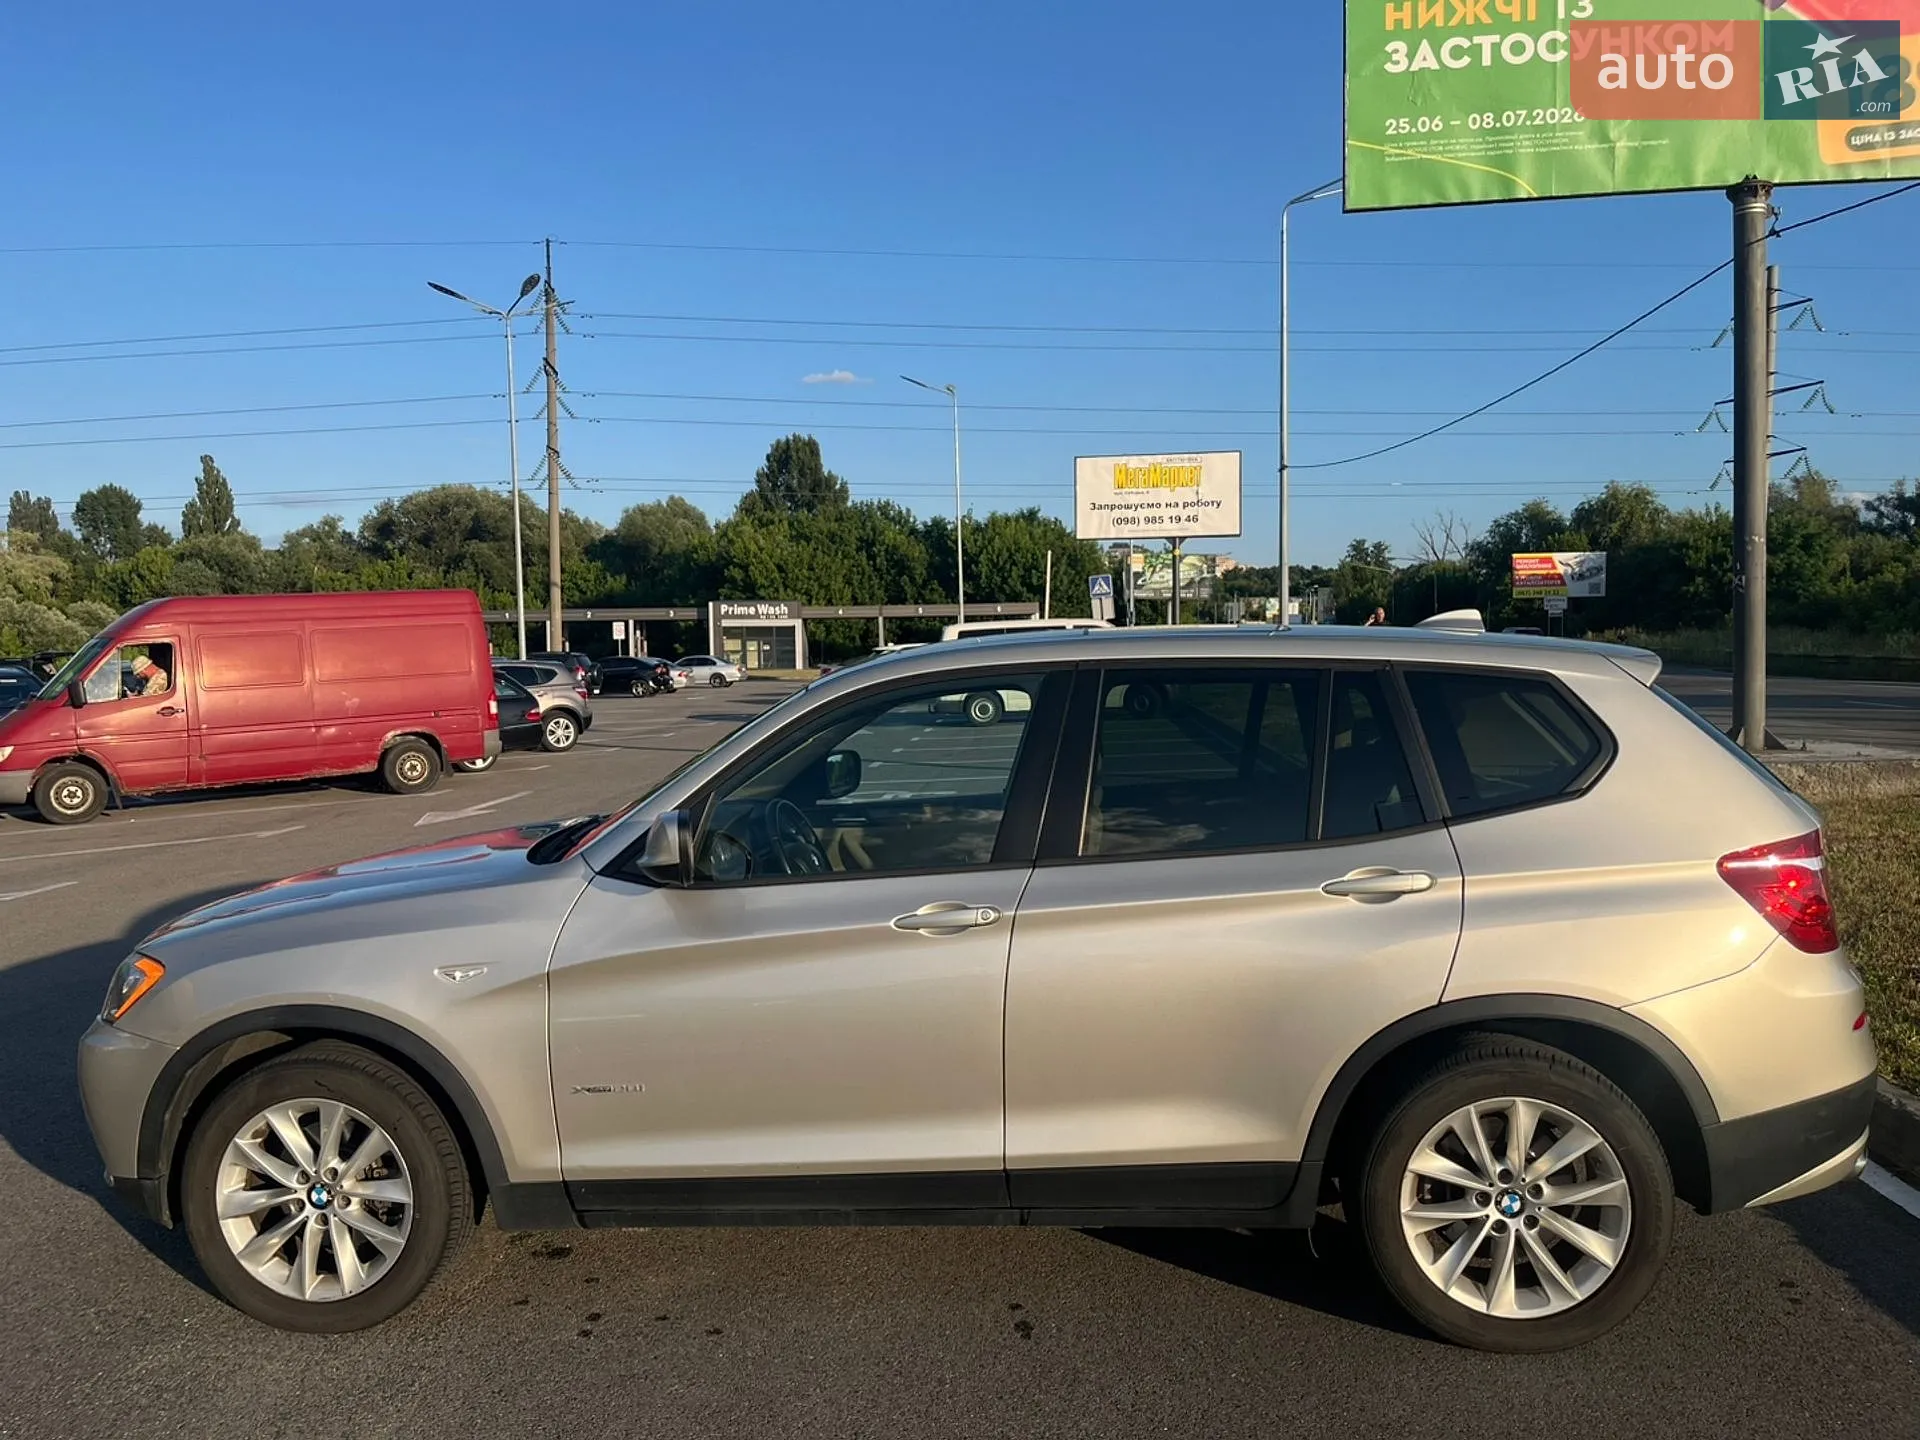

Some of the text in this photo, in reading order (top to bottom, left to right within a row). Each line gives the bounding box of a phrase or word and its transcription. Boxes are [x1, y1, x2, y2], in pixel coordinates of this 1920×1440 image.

[1383, 20, 1735, 74] ЗАСТОСУНКОМ
[1385, 115, 1444, 135] 25.06
[1468, 107, 1586, 130] 08.07.2026
[1113, 463, 1202, 492] МегаМаркет
[1165, 501, 1179, 510] на
[1182, 499, 1222, 510] роботу
[1112, 514, 1199, 527] (098) 985 19 46
[721, 603, 789, 616] Prime Wash
